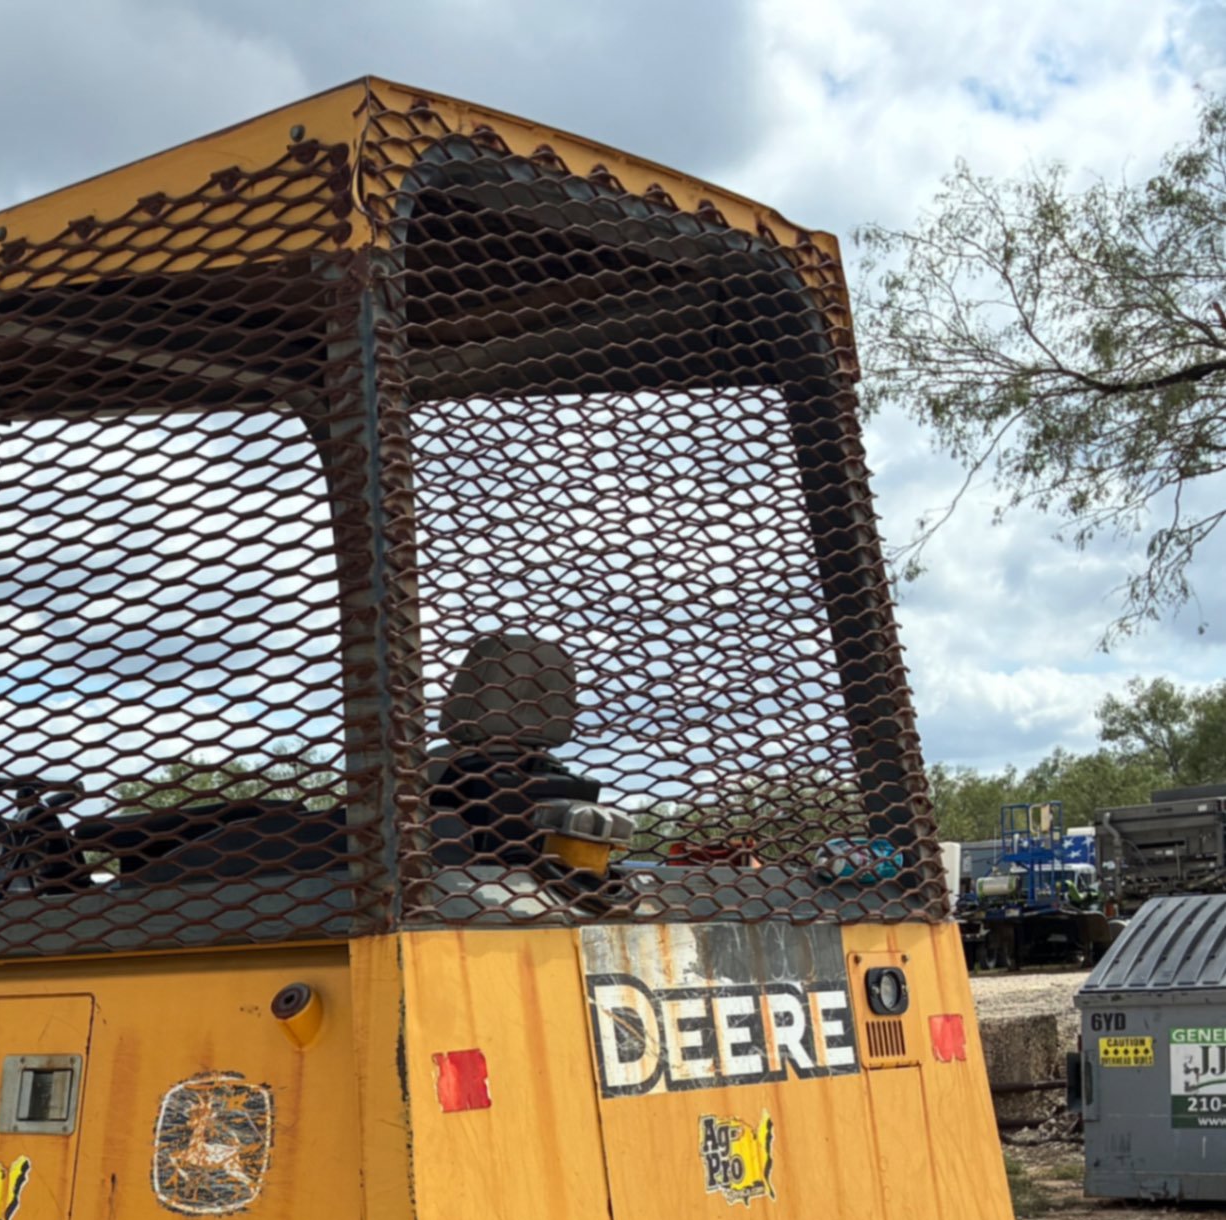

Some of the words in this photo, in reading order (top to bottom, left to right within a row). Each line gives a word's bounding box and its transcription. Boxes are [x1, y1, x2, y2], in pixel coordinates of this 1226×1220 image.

[1091, 1012, 1127, 1032] 6YD
[590, 980, 858, 1091] DEERE
[1106, 1038, 1146, 1048] CAUTION
[1172, 1028, 1226, 1042] GENE
[706, 1152, 744, 1187] Pro
